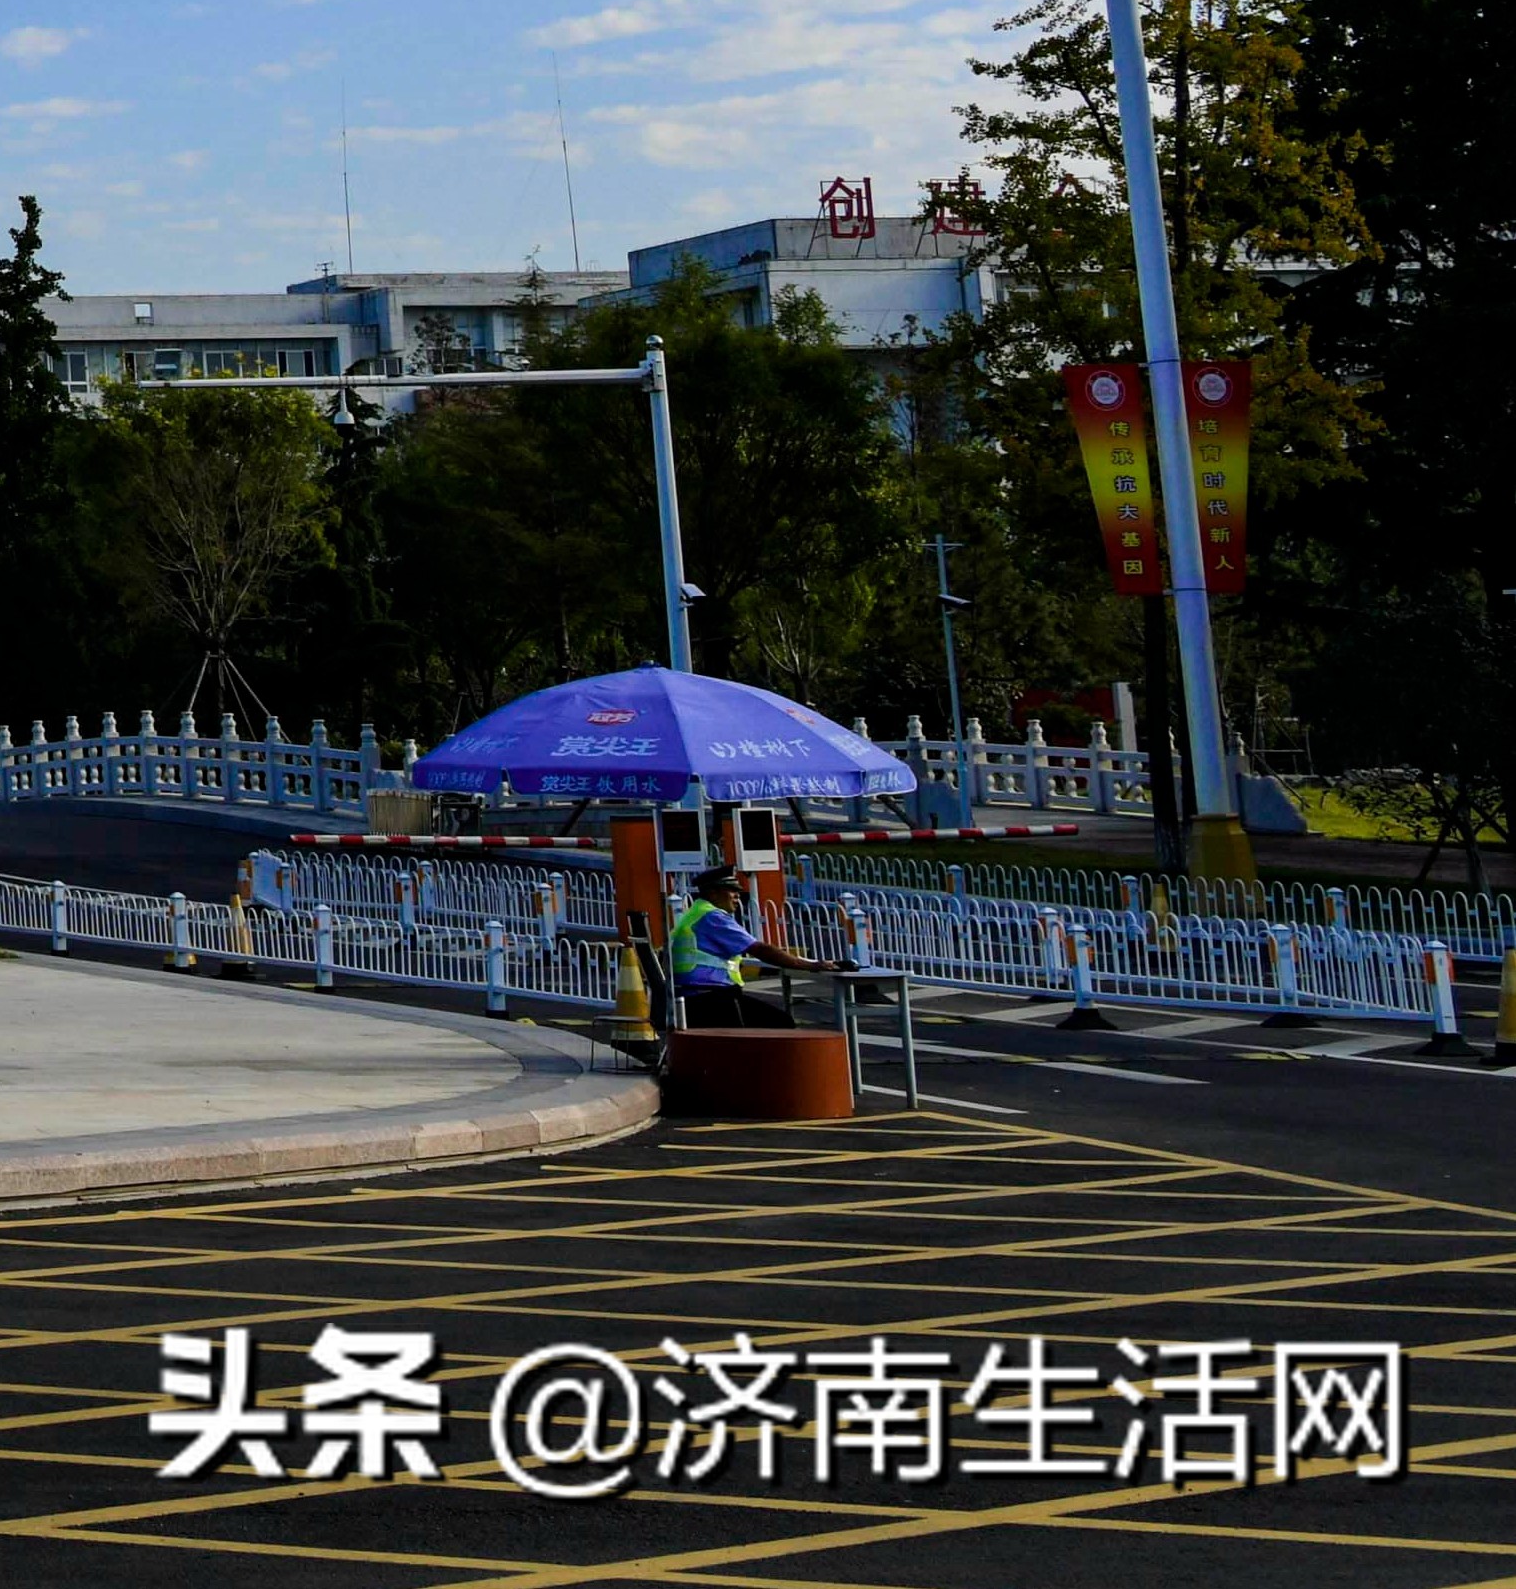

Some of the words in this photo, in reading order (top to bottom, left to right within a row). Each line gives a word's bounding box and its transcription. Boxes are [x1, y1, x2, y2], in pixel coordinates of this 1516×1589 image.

[1109, 420, 1144, 575] 传承抗大基因
[1197, 418, 1235, 571] 培育时代新人
